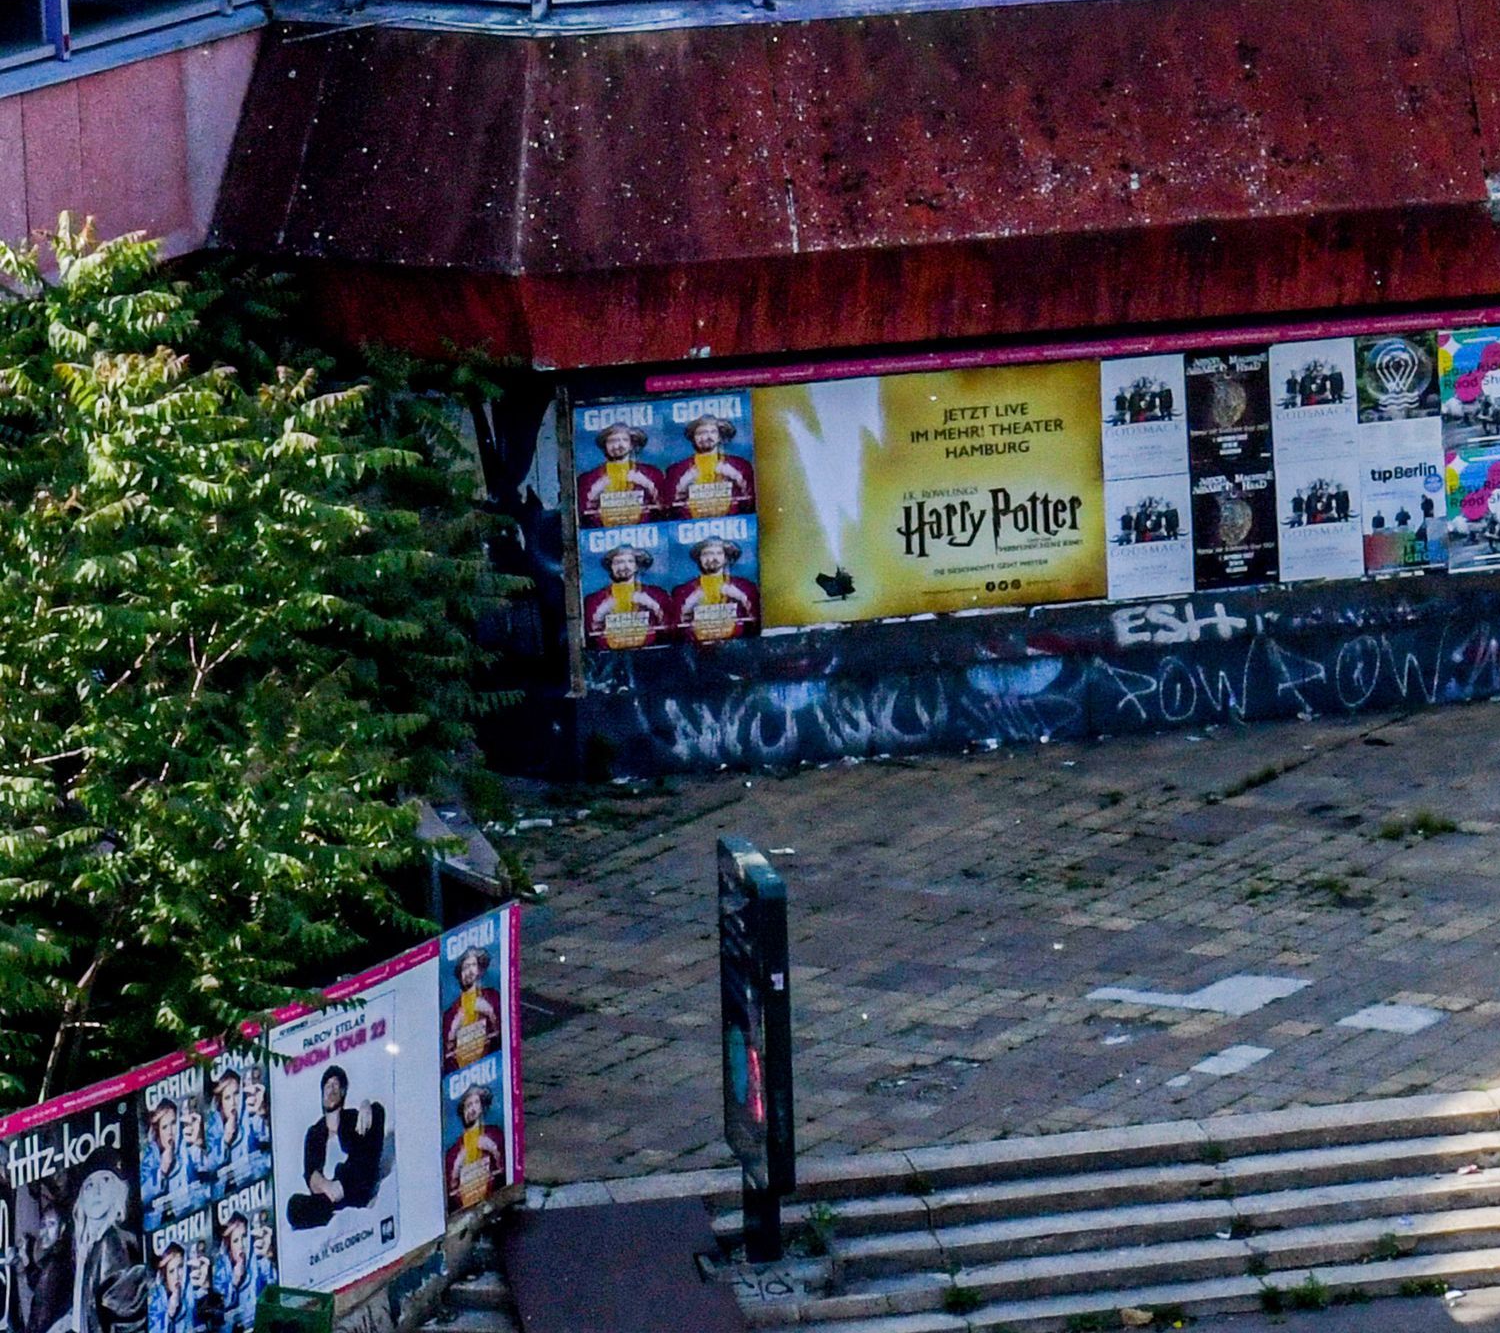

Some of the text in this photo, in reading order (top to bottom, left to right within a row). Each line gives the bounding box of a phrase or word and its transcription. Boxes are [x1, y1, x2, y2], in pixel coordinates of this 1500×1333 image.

[1444, 376, 1478, 389] Road
[943, 402, 1029, 425] JETZT LIVE
[911, 418, 1064, 443] IM MEHR! THEATER
[945, 440, 1030, 459] HAMBURG
[897, 487, 1083, 557] Harry Potter
[333, 1013, 366, 1038] STELAR
[333, 1029, 367, 1058] TOUR
[7, 1111, 121, 1190] fritz-kola
[331, 1227, 374, 1257] VELODROM
